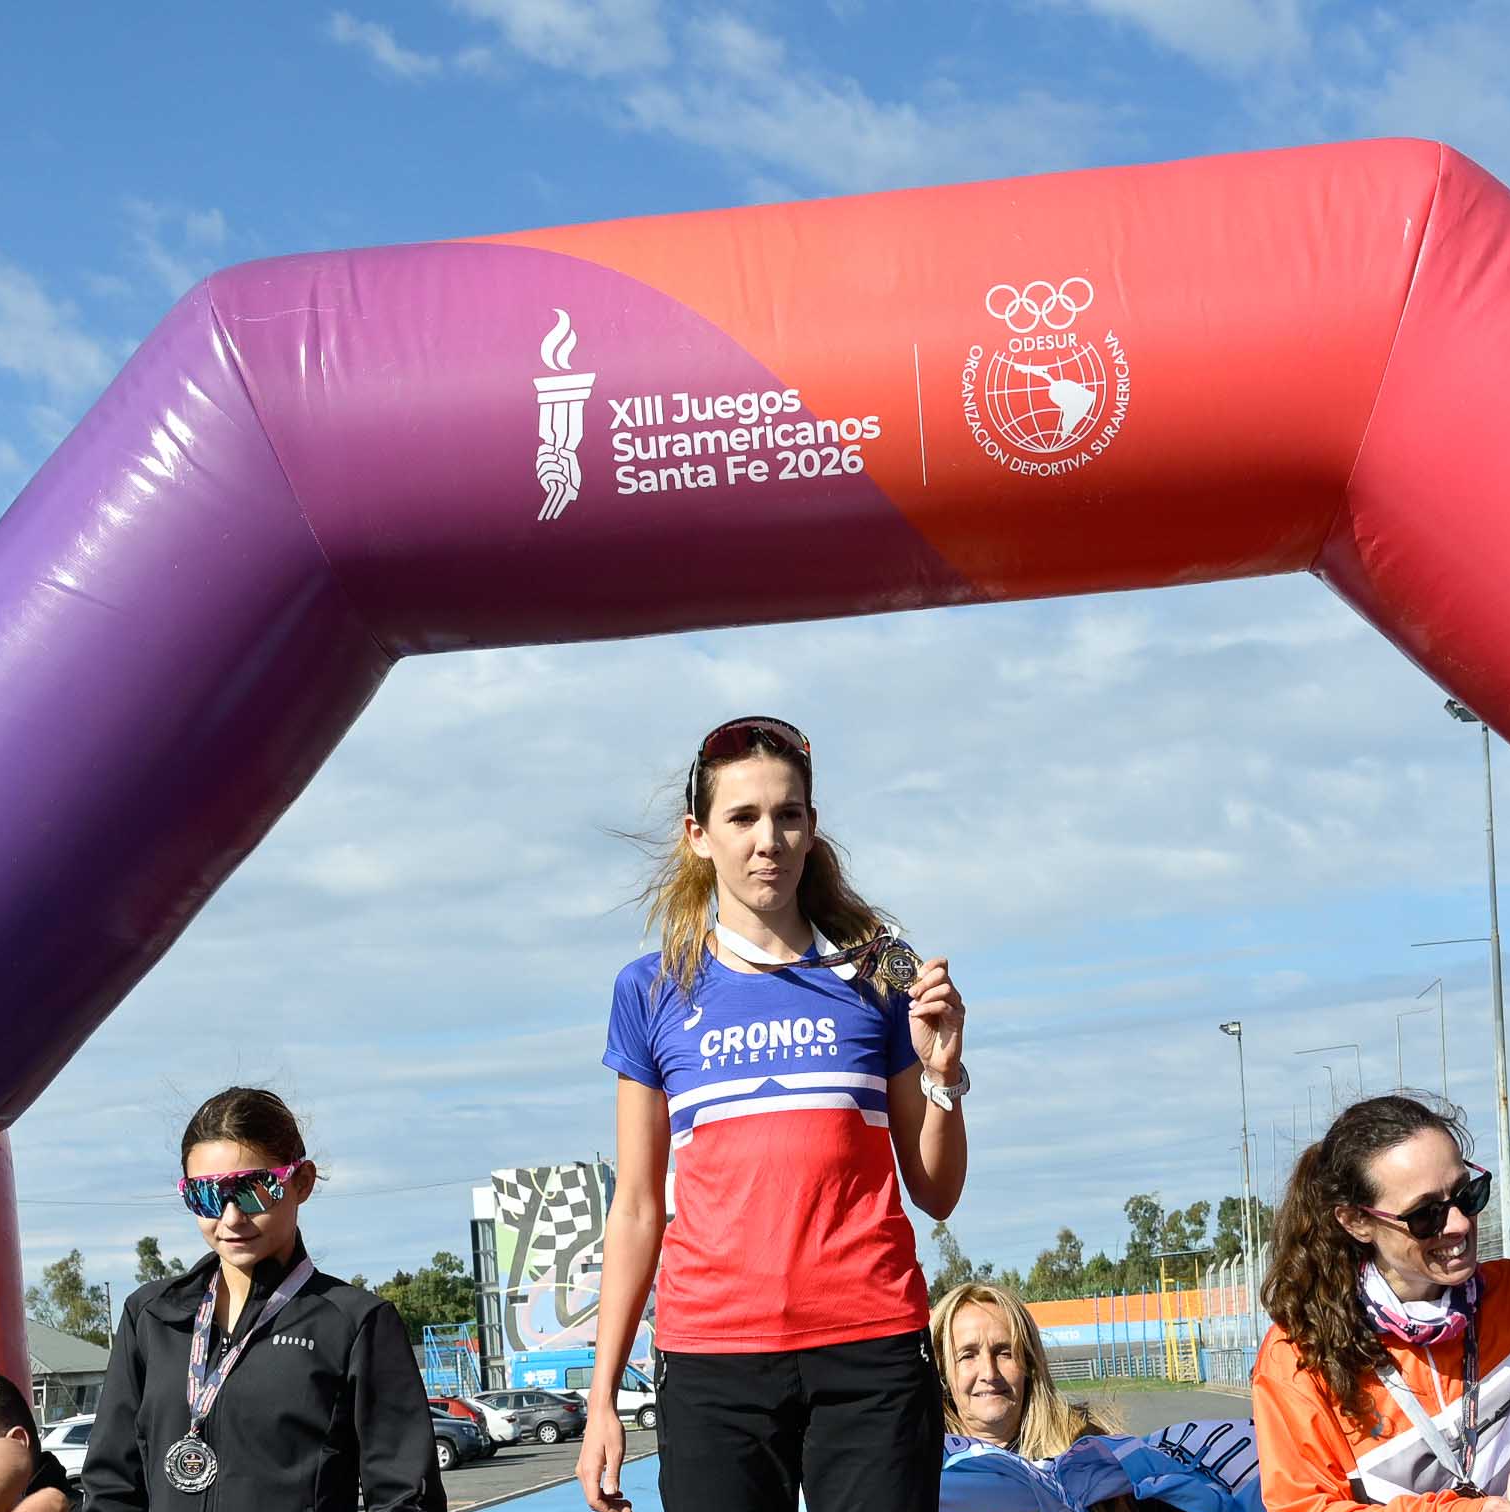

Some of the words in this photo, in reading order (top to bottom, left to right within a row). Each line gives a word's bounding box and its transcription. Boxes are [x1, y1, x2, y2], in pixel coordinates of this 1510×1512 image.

[1008, 333, 1078, 354] ODESUR
[607, 394, 665, 430] XIII
[671, 387, 802, 425] Juegos
[961, 344, 1010, 467] ORGANIZACION
[1009, 450, 1093, 477] DEPORTIVA
[1090, 329, 1131, 456] SURAMERICANA
[611, 414, 882, 464] Suramericanos
[614, 462, 718, 496] Santa
[725, 455, 770, 486] Fe
[776, 443, 865, 482] 2026
[699, 1017, 837, 1058] CRONOS
[700, 1045, 839, 1072] ATLETISMO
